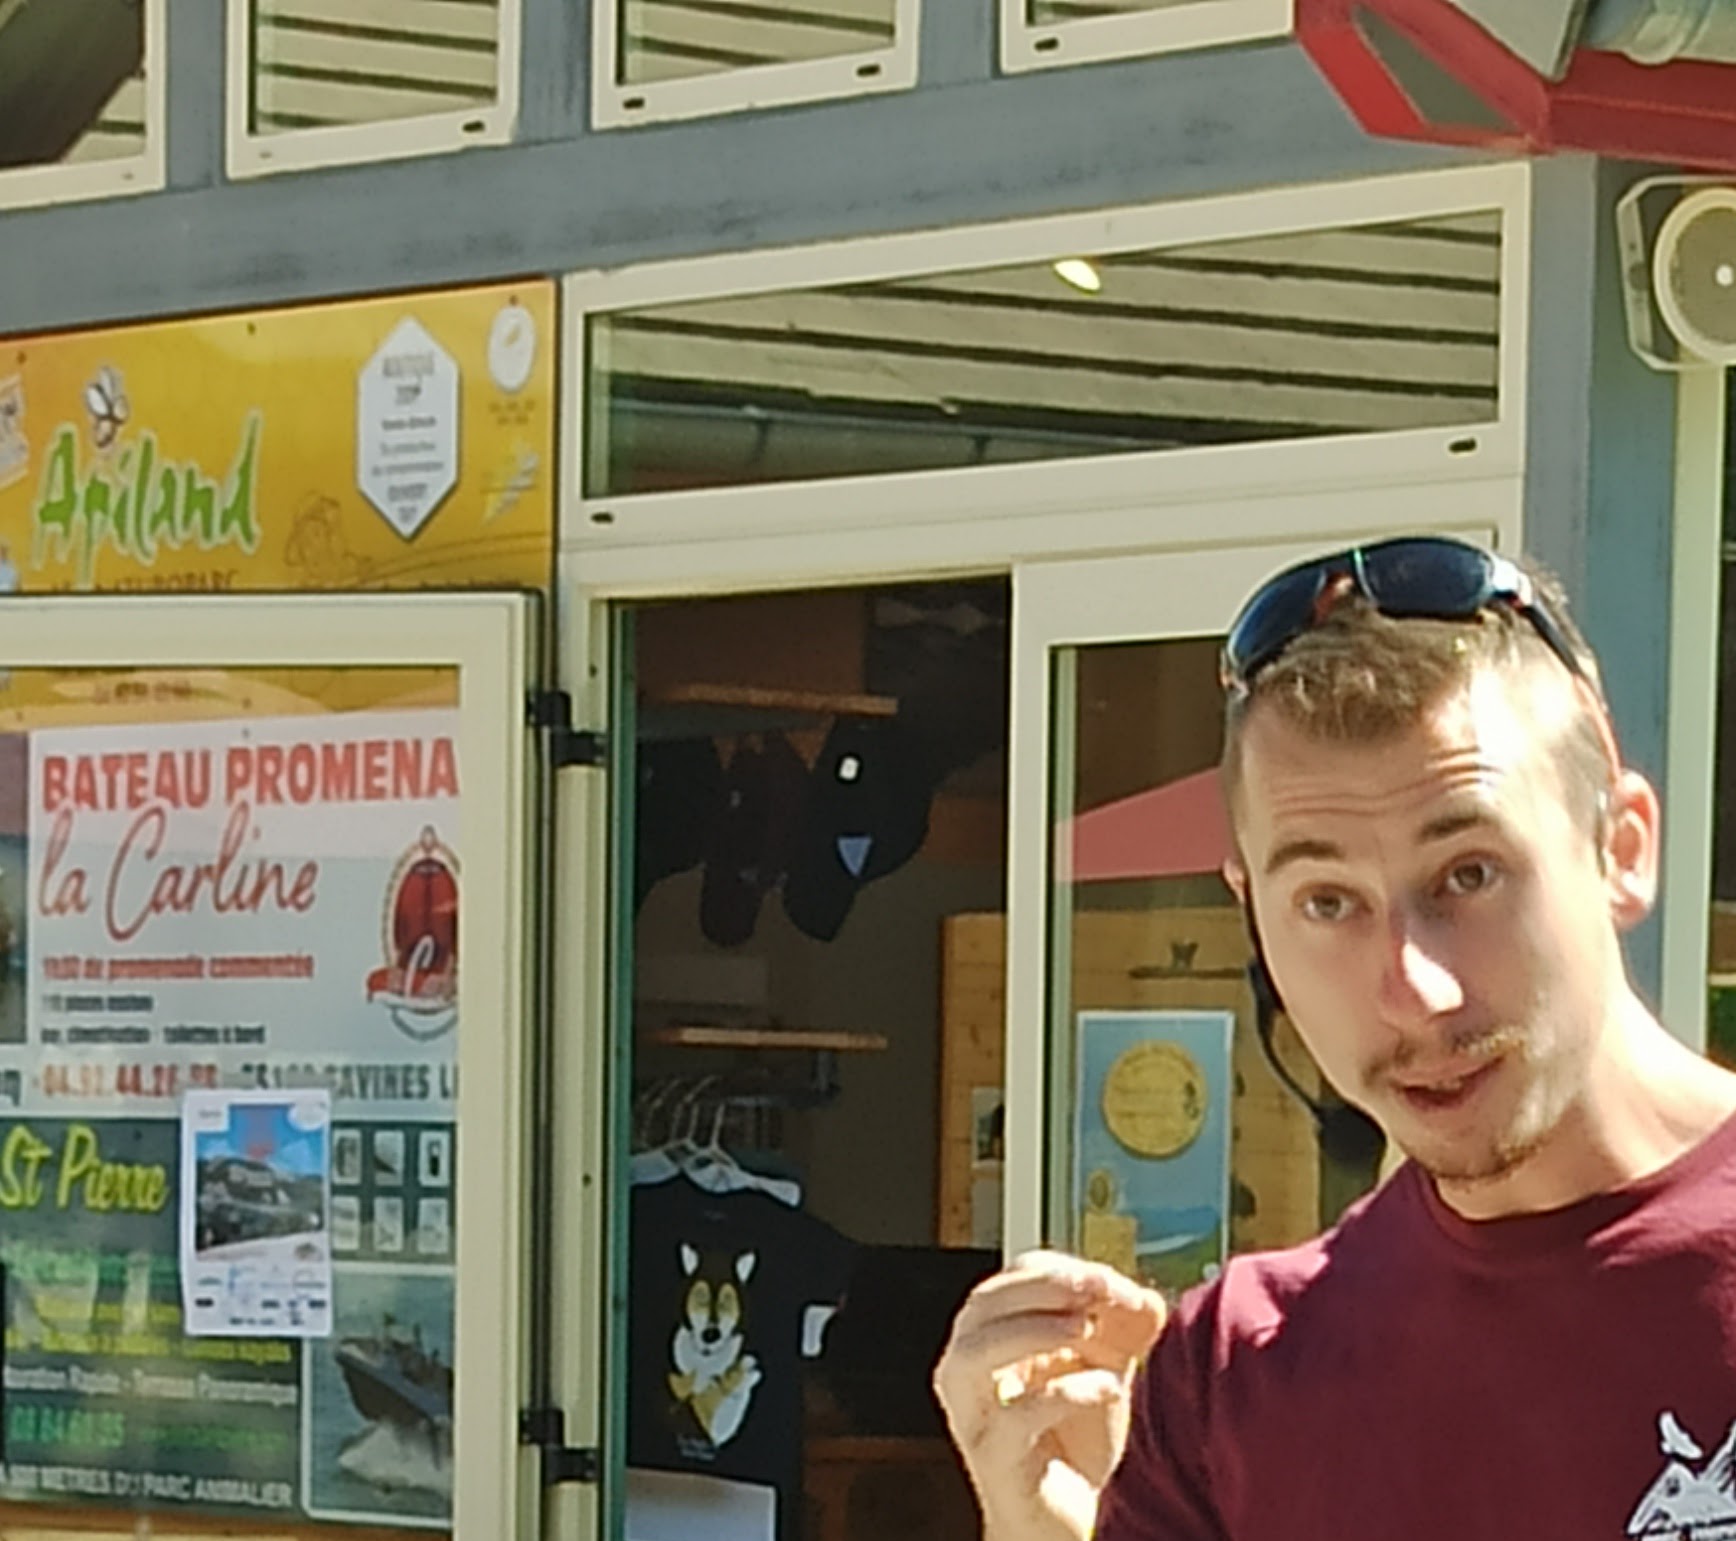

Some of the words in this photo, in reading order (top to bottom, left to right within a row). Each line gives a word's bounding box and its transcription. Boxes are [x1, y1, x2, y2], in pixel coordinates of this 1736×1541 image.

[34, 411, 260, 590] Apiland
[42, 749, 210, 812] BATEAU
[225, 737, 458, 808] PROMENA
[38, 809, 89, 917] la
[105, 802, 320, 941] Carline
[1, 1125, 52, 1208] St
[57, 1125, 168, 1213] Pierre
[144, 1472, 191, 1499] PARC
[194, 1478, 293, 1507] ANIMALIER
